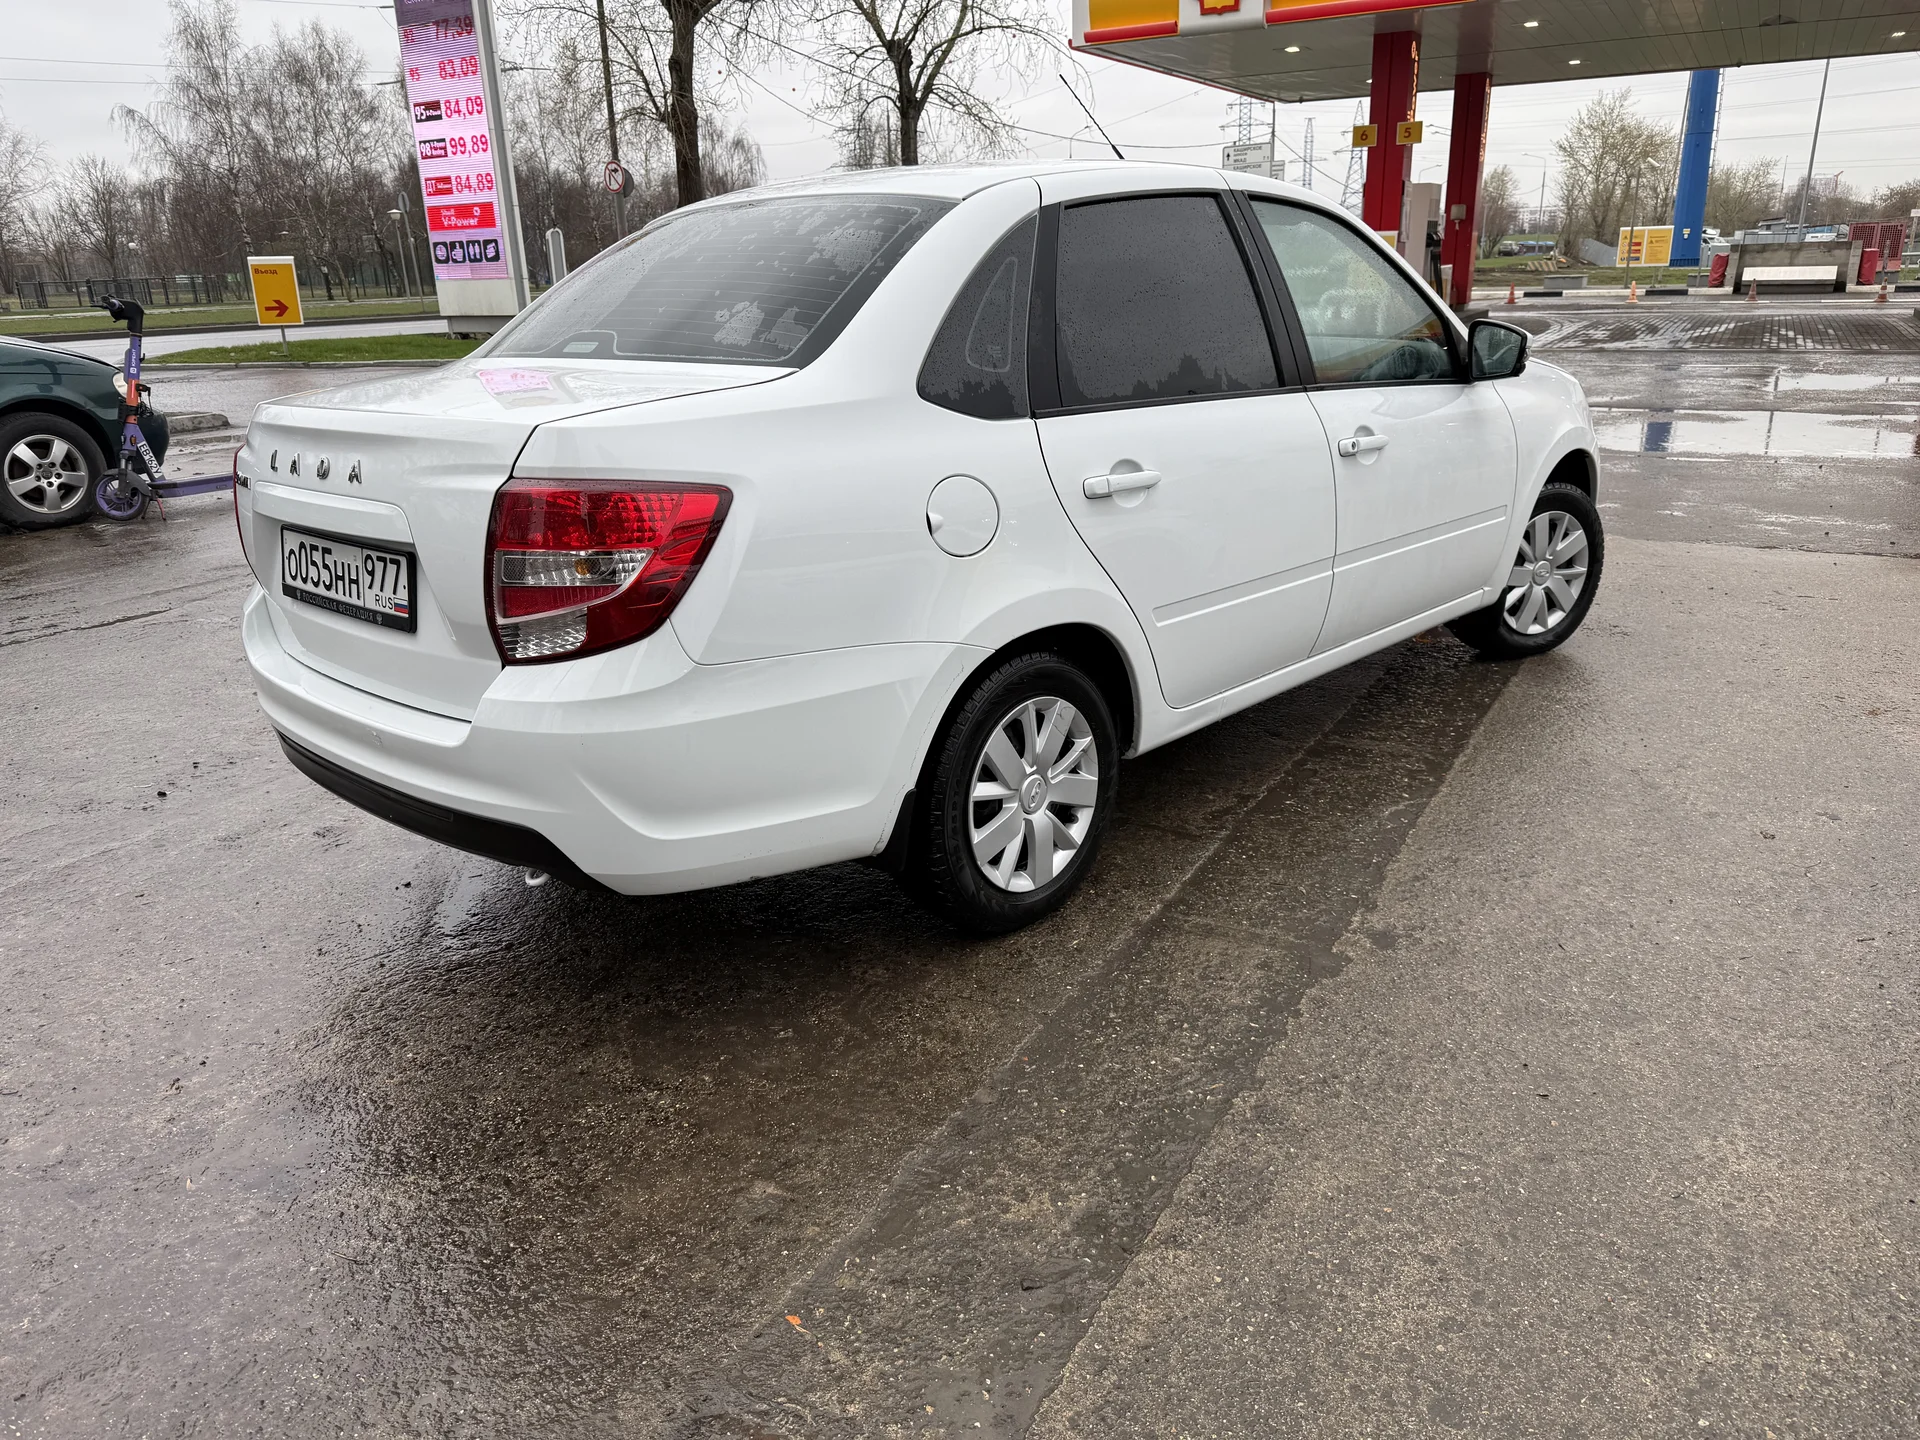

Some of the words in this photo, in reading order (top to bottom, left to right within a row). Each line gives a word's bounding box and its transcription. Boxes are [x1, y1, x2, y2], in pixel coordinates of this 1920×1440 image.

[438, 55, 478, 80] 83,09
[415, 105, 426, 120] 95
[444, 95, 483, 120] 84,09
[420, 142, 431, 157] 98
[449, 133, 489, 158] 99,89
[1360, 130, 1369, 141] 6
[1403, 127, 1412, 139] 5
[455, 172, 494, 195] 84,89
[270, 449, 363, 484] LADA
[363, 553, 401, 596] 977
[302, 592, 338, 609] РОССИЙСКАЯ
[338, 604, 374, 622] ФЕДЕРАЦИЯ
[374, 593, 394, 610] RUS
